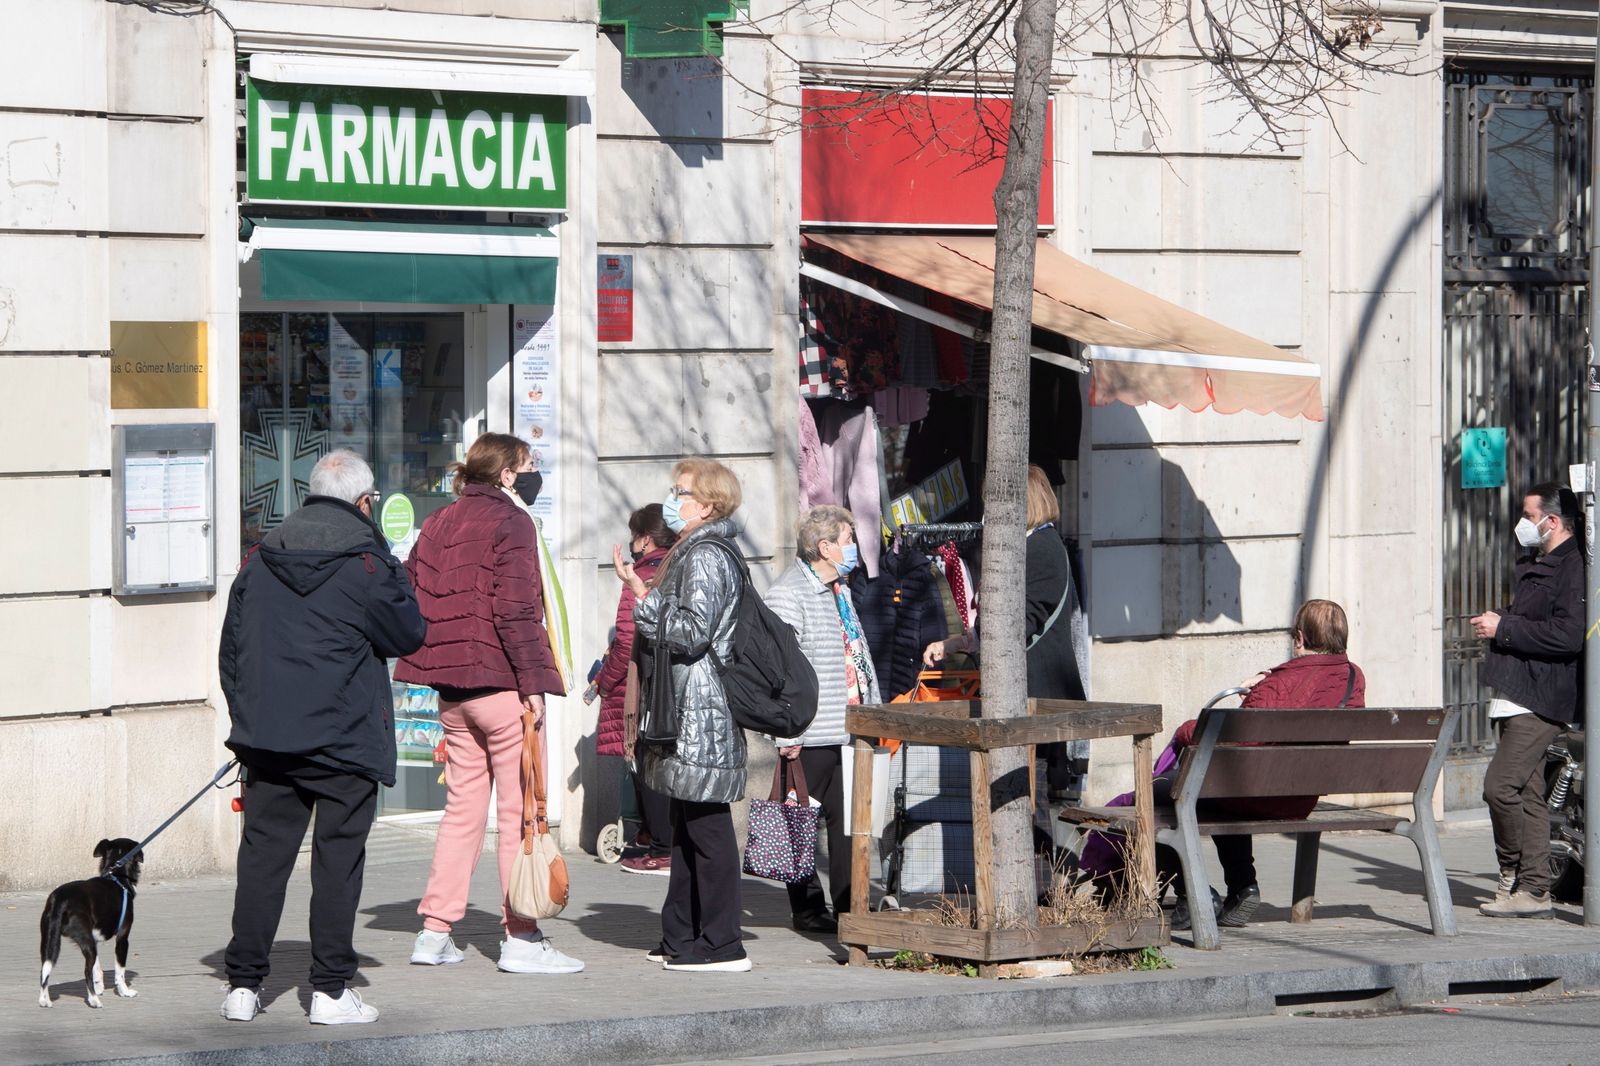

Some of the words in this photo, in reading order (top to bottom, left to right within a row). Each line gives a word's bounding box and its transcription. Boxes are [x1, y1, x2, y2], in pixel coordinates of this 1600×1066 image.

[258, 90, 556, 191] FARMÀCIA
[598, 295, 628, 305] Alarma
[124, 361, 133, 374] C.
